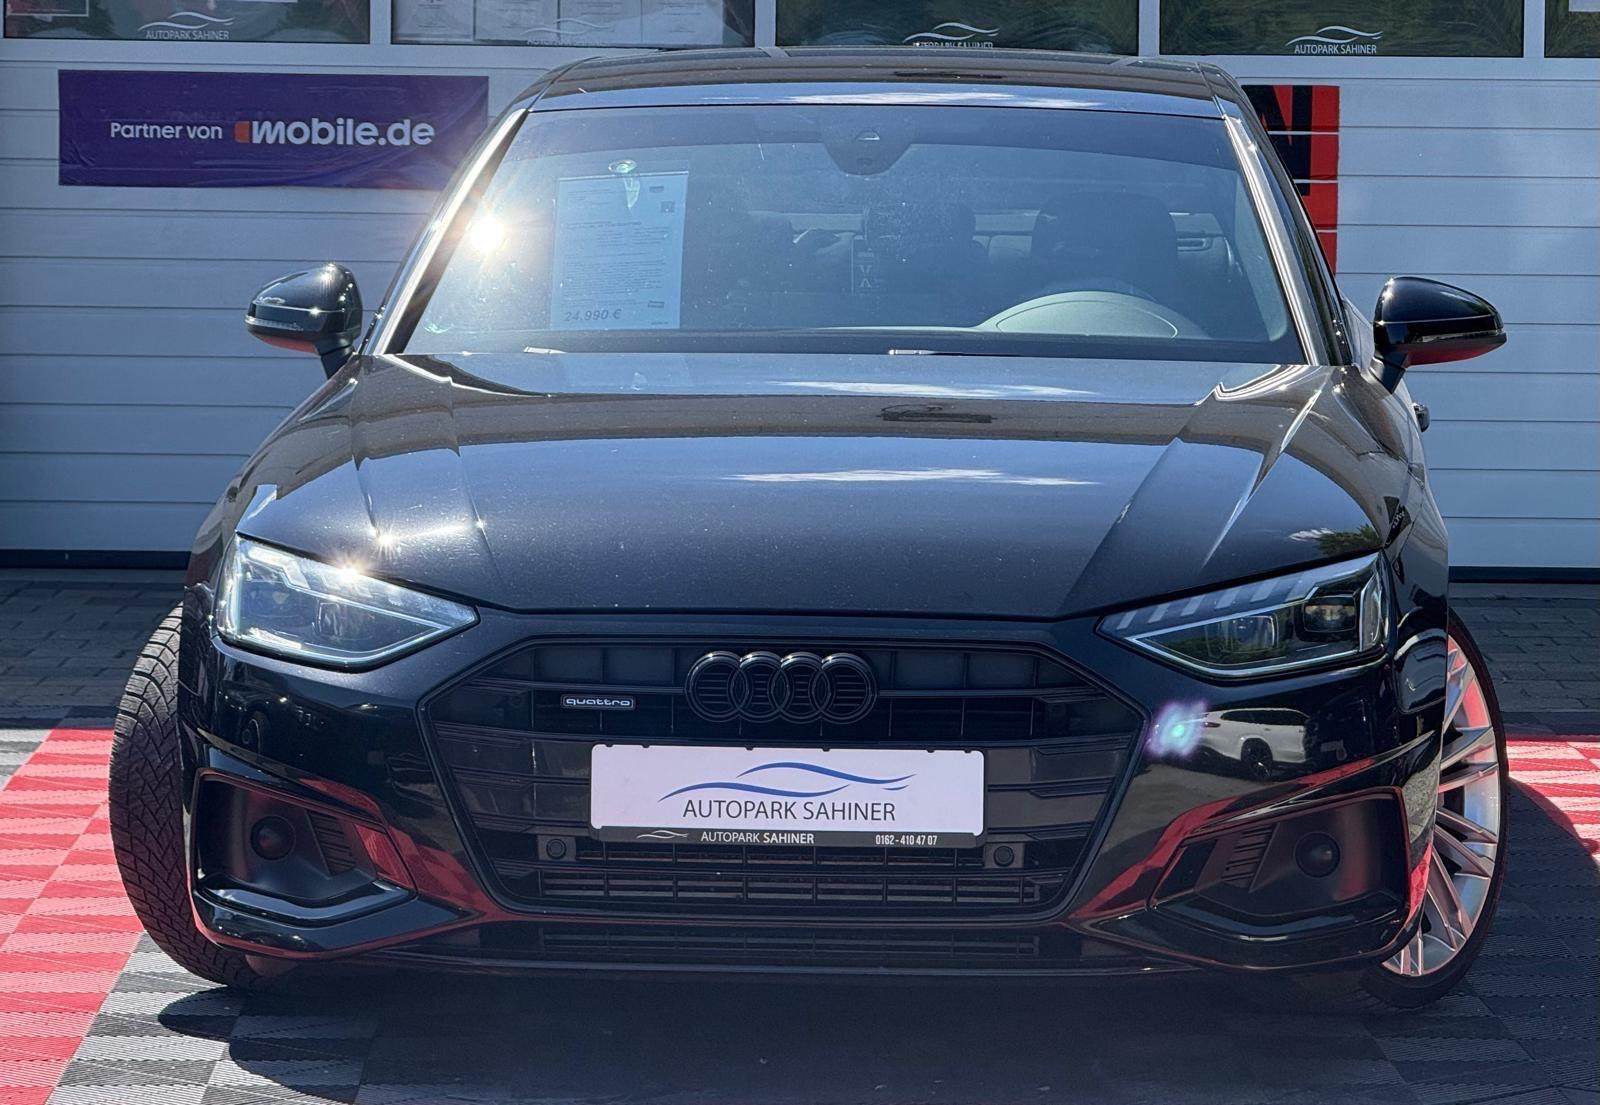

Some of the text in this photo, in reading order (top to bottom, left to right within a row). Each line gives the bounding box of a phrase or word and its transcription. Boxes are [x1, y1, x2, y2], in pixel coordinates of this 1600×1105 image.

[145, 30, 230, 40] AUTOPARK SAHINER
[1294, 44, 1377, 54] AUTOPARK SAHINER
[110, 117, 435, 147] Partner von mobile.de
[565, 308, 622, 322] 24.990 €
[566, 698, 631, 706] quattro
[682, 799, 896, 822] AUTOPARK SAHINER
[700, 831, 815, 845] AUTOPARK SAHINER
[915, 835, 926, 846] 47
[927, 835, 938, 846] 07
